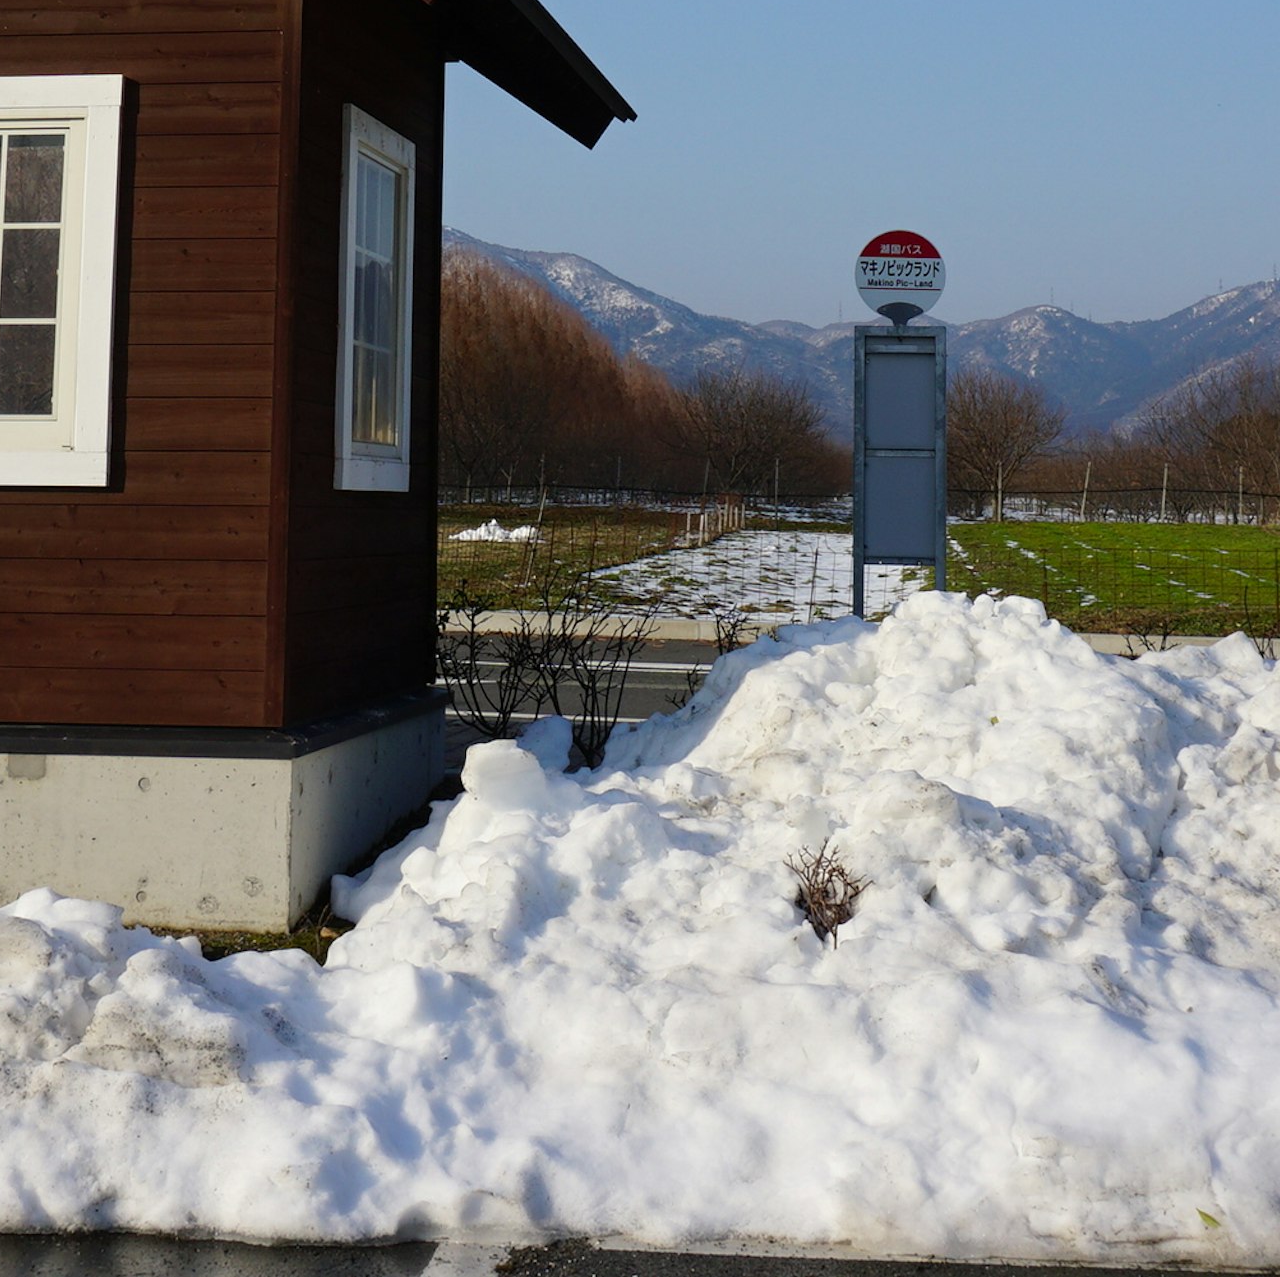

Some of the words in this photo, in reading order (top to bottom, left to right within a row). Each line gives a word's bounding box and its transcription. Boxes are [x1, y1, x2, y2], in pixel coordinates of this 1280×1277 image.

[880, 244, 922, 254] 湖国バス
[860, 260, 940, 277] マキノピックランド
[867, 279, 894, 287] Makino
[896, 279, 933, 287] Pic-Land
